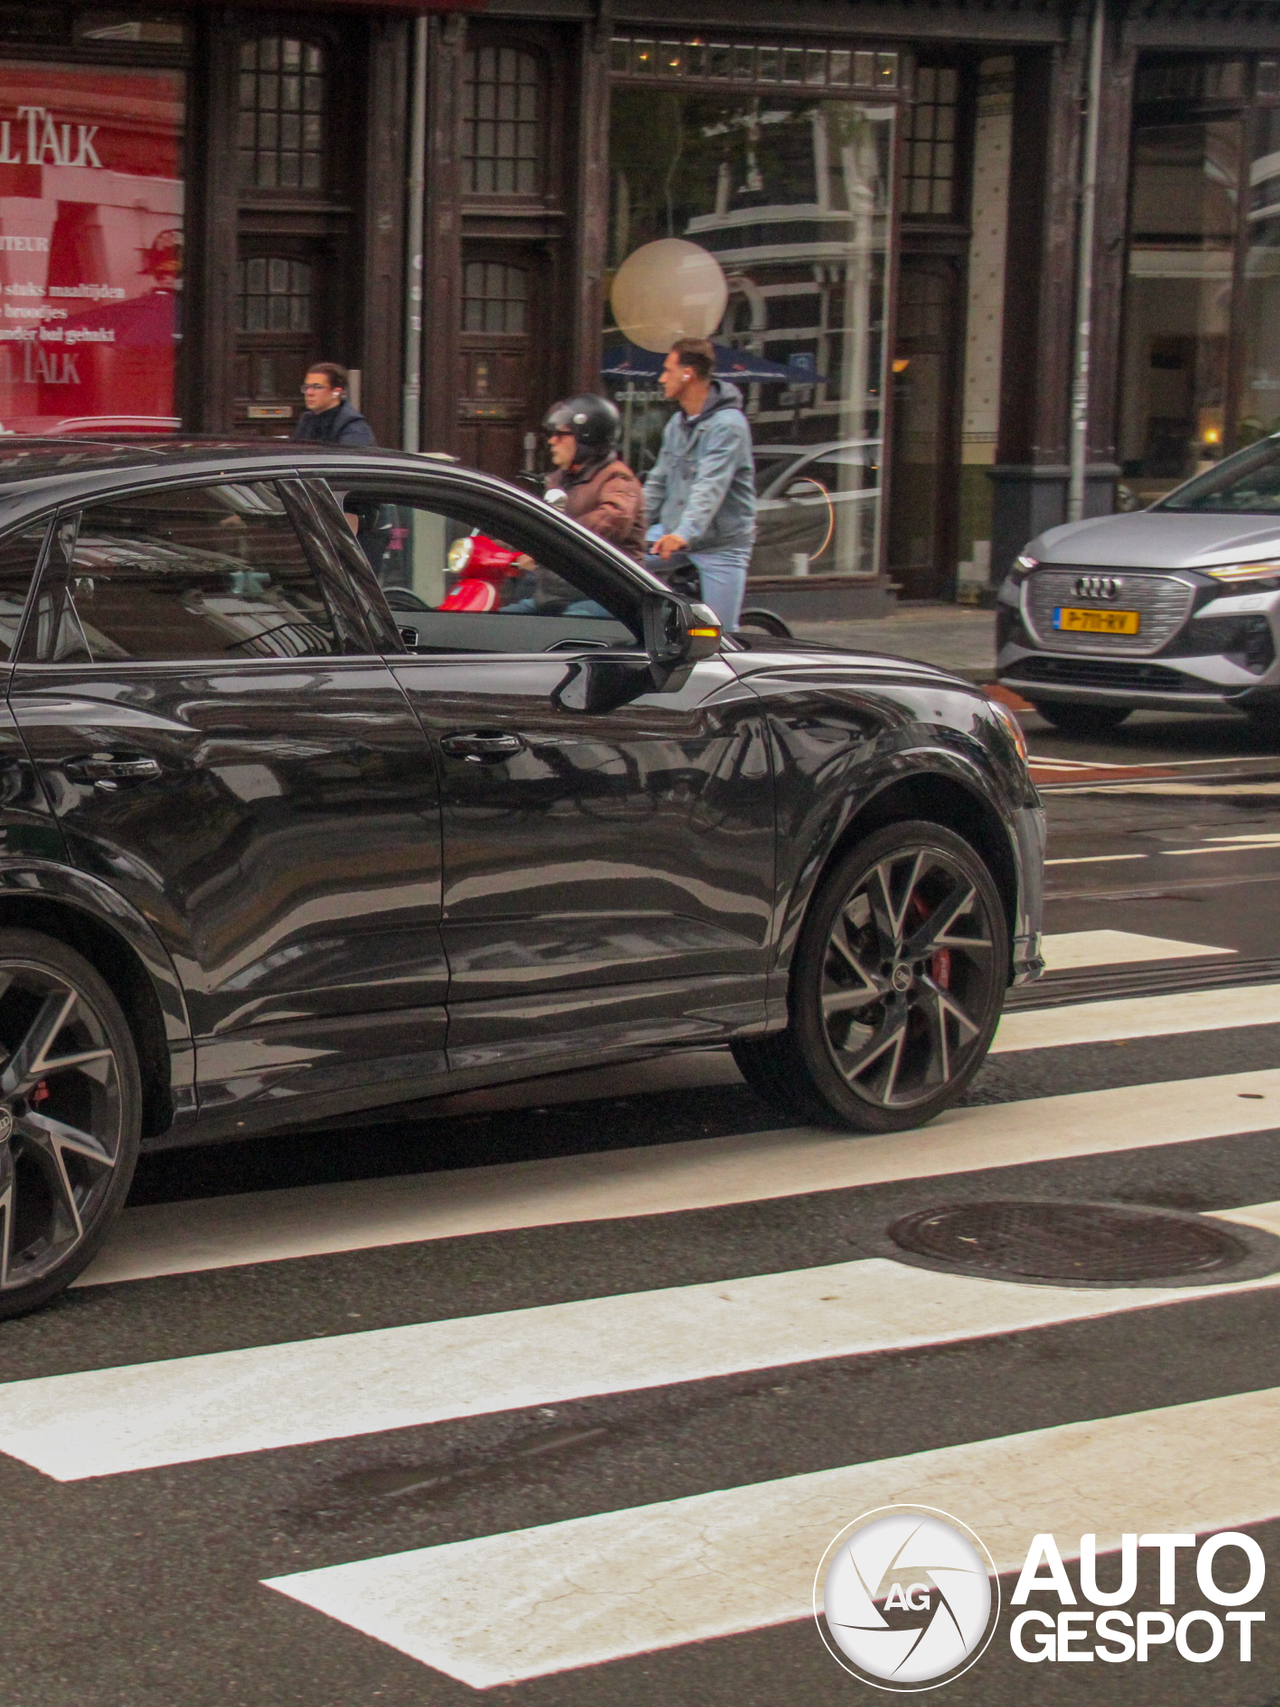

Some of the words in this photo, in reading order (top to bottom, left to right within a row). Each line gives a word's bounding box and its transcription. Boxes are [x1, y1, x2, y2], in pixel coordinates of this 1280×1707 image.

[18, 106, 103, 168] TALK
[5, 282, 46, 296] stuks
[49, 284, 125, 301] maaltijden
[5, 303, 67, 322] broodjes
[65, 327, 115, 345] gehakt
